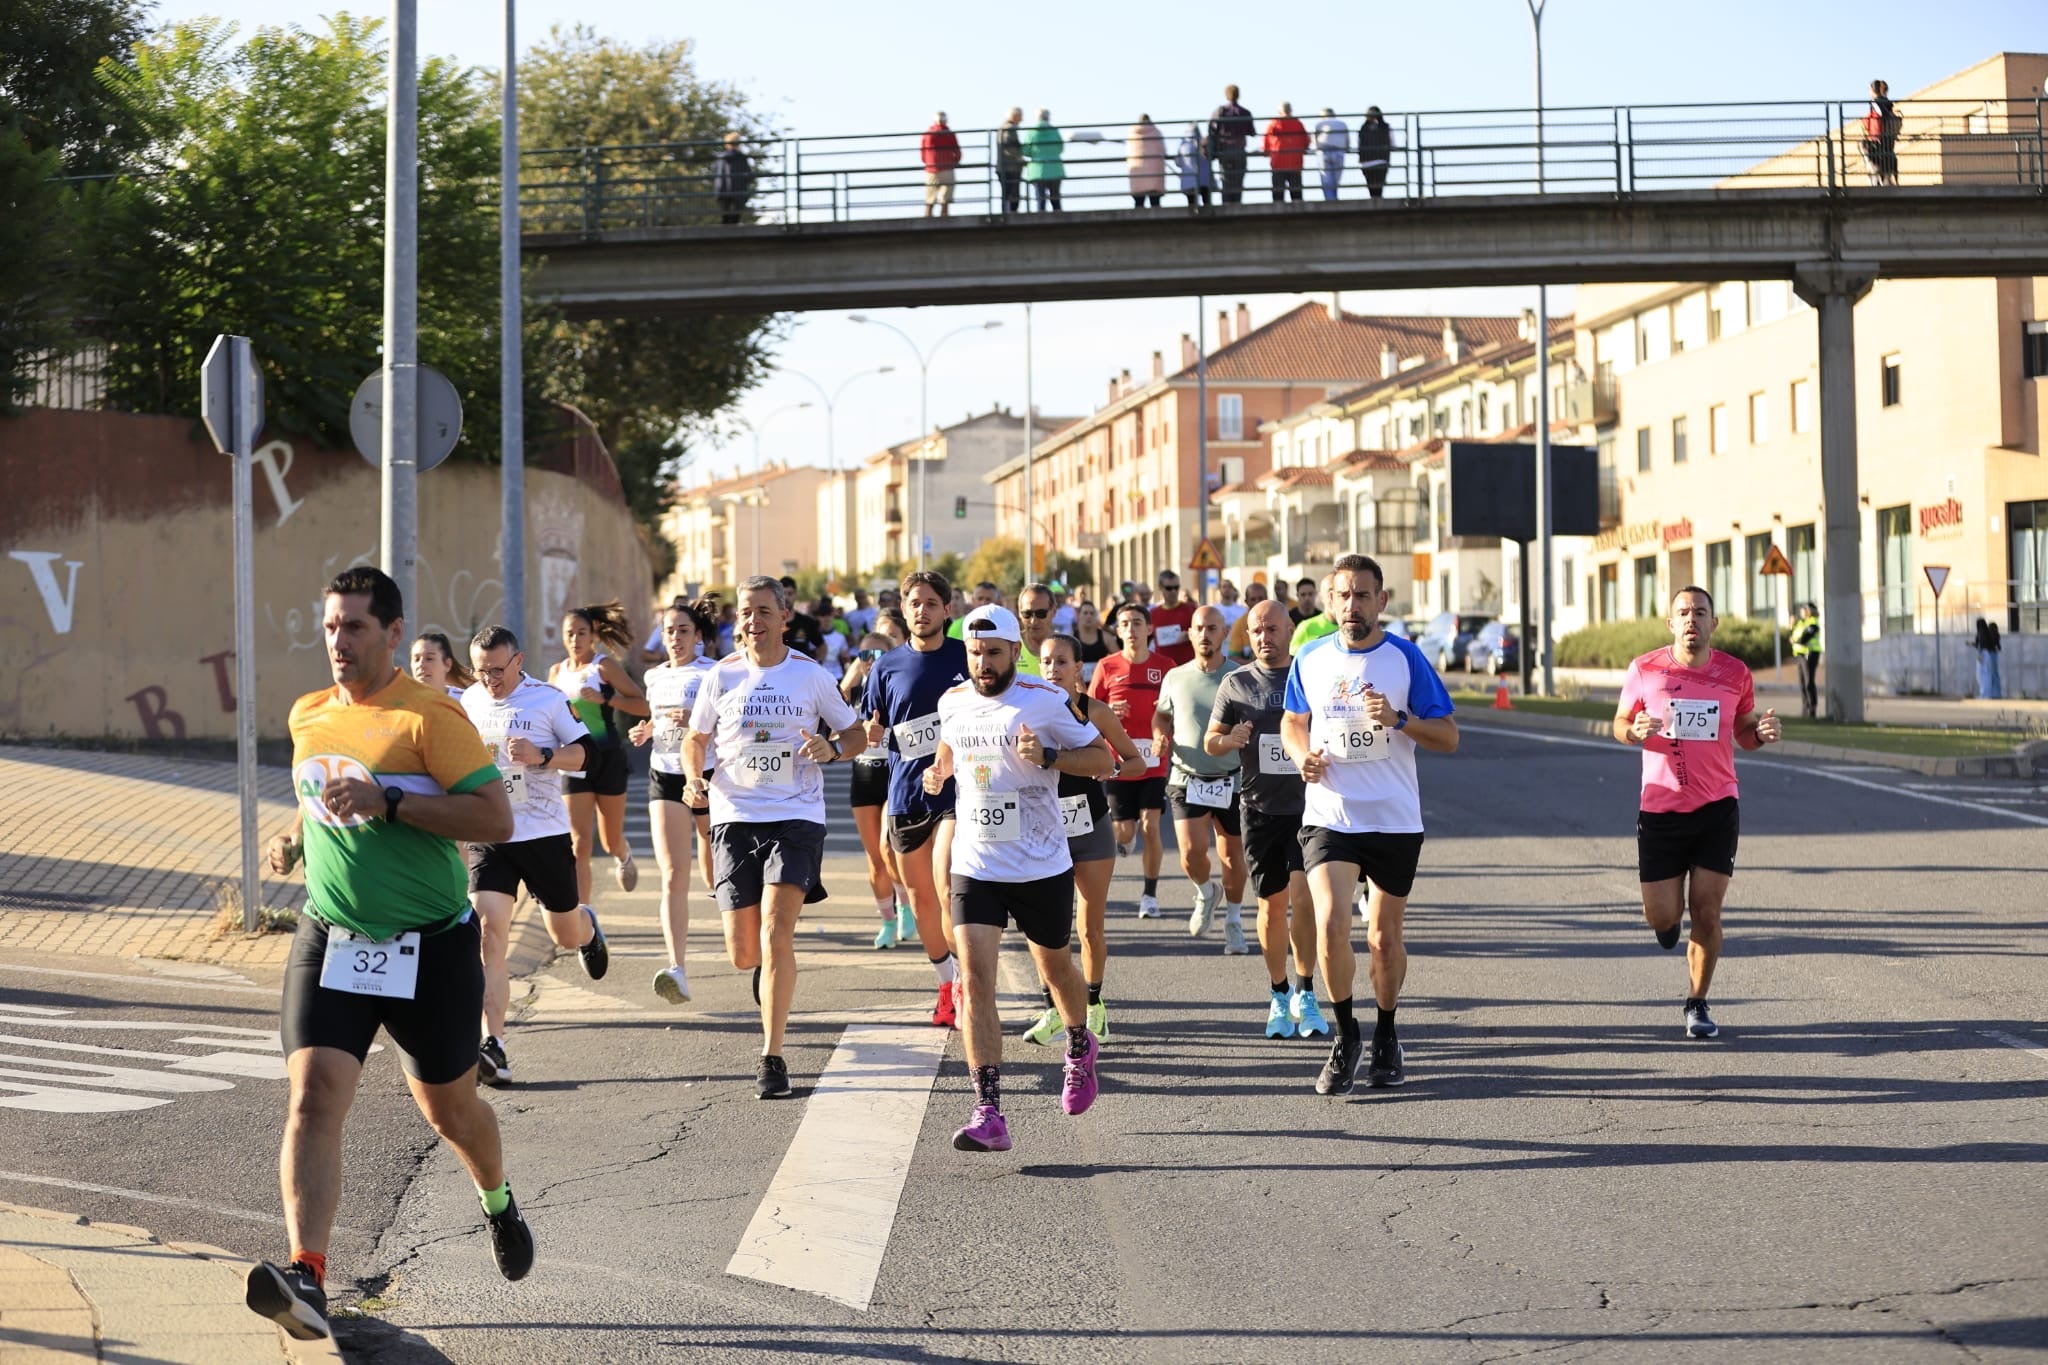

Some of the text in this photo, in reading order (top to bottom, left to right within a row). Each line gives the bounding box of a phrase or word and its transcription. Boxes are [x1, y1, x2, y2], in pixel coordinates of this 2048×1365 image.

[9, 551, 84, 634] V
[749, 695, 791, 704] CARRERA
[775, 705, 804, 717] CIVIL
[1675, 711, 1707, 727] 175
[503, 719, 533, 731] CIVIL
[906, 727, 936, 748] 270
[1340, 731, 1374, 748] 169
[747, 756, 781, 772] 430
[1197, 784, 1224, 797] 142
[970, 808, 1005, 826] 439
[353, 950, 388, 975] 32
